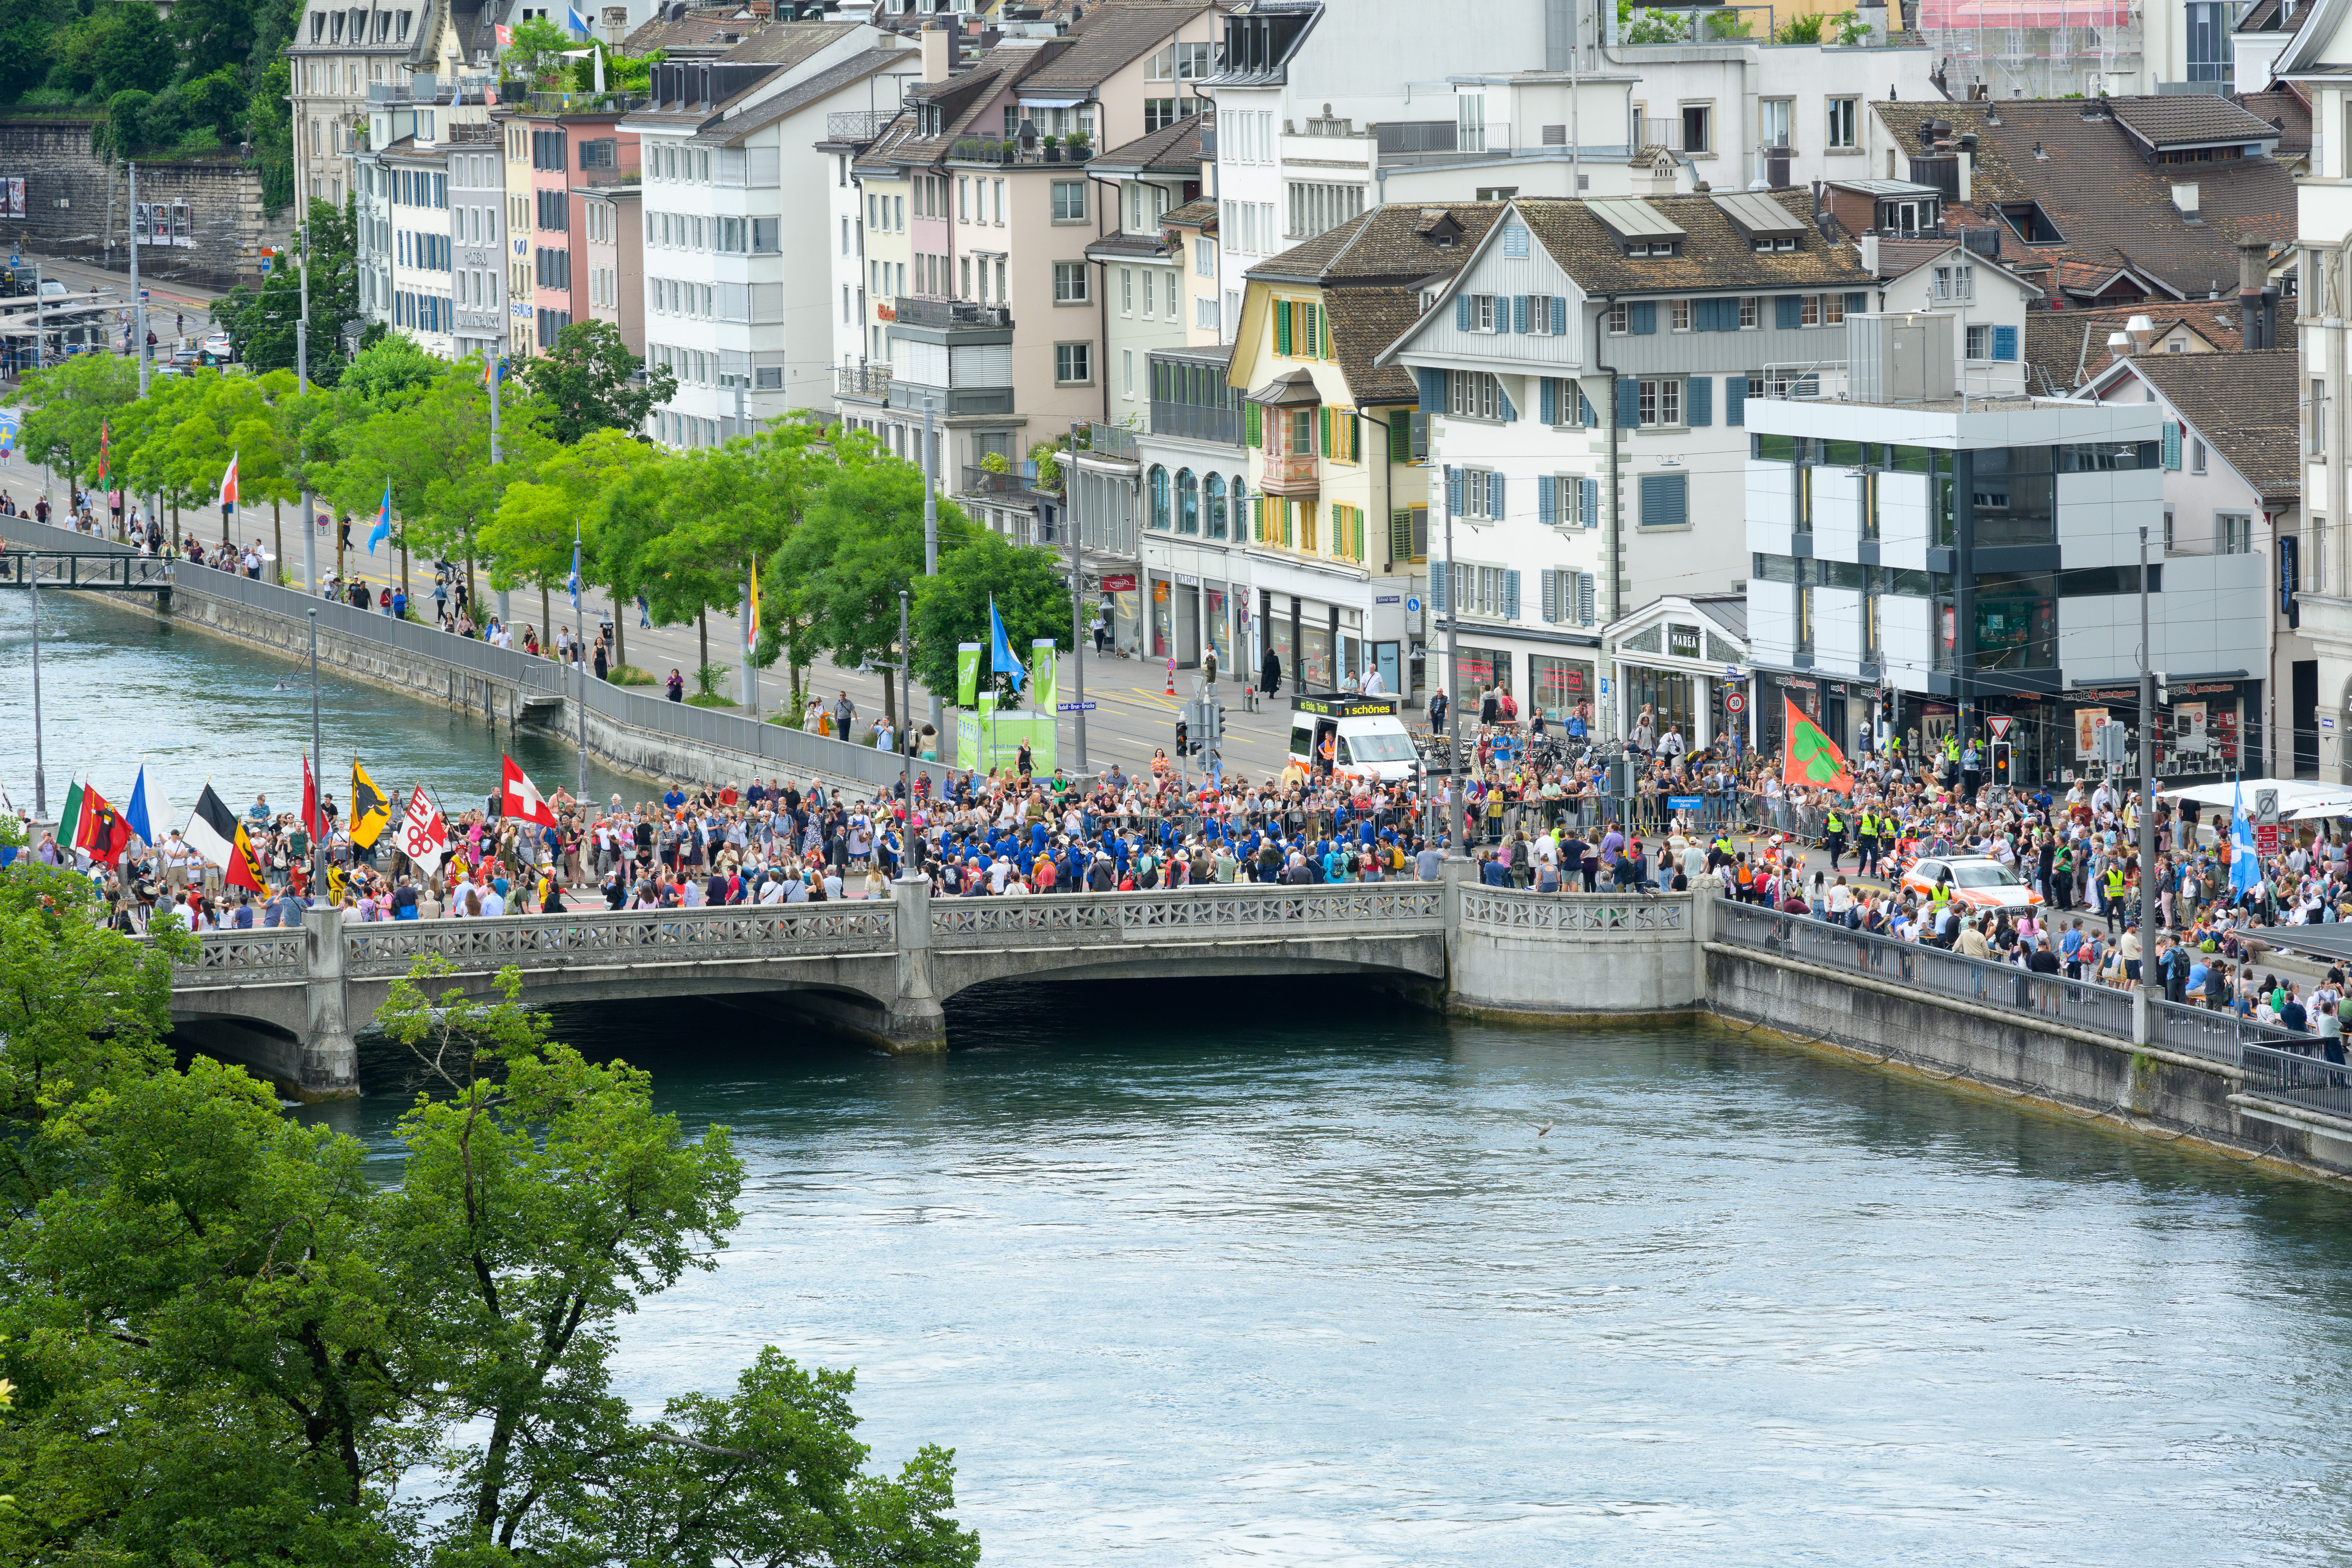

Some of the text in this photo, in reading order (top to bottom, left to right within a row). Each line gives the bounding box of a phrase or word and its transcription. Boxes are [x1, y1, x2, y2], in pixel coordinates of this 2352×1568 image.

[465, 251, 487, 264] HOTEL
[457, 313, 499, 329] LIMMATBLICK
[1178, 574, 1197, 586] TARZAN
[1673, 634, 1696, 648] MAREA
[1457, 663, 1490, 674] EINZELSTÜCK
[1546, 673, 1580, 685] EINZELSTÜCK
[1803, 680, 1816, 689] Megastore
[1602, 680, 1606, 692] P
[2210, 684, 2234, 693] Megastore
[1306, 701, 1316, 713] Eidg.
[1352, 704, 1390, 715] schönes
[1991, 792, 2002, 804] 30
